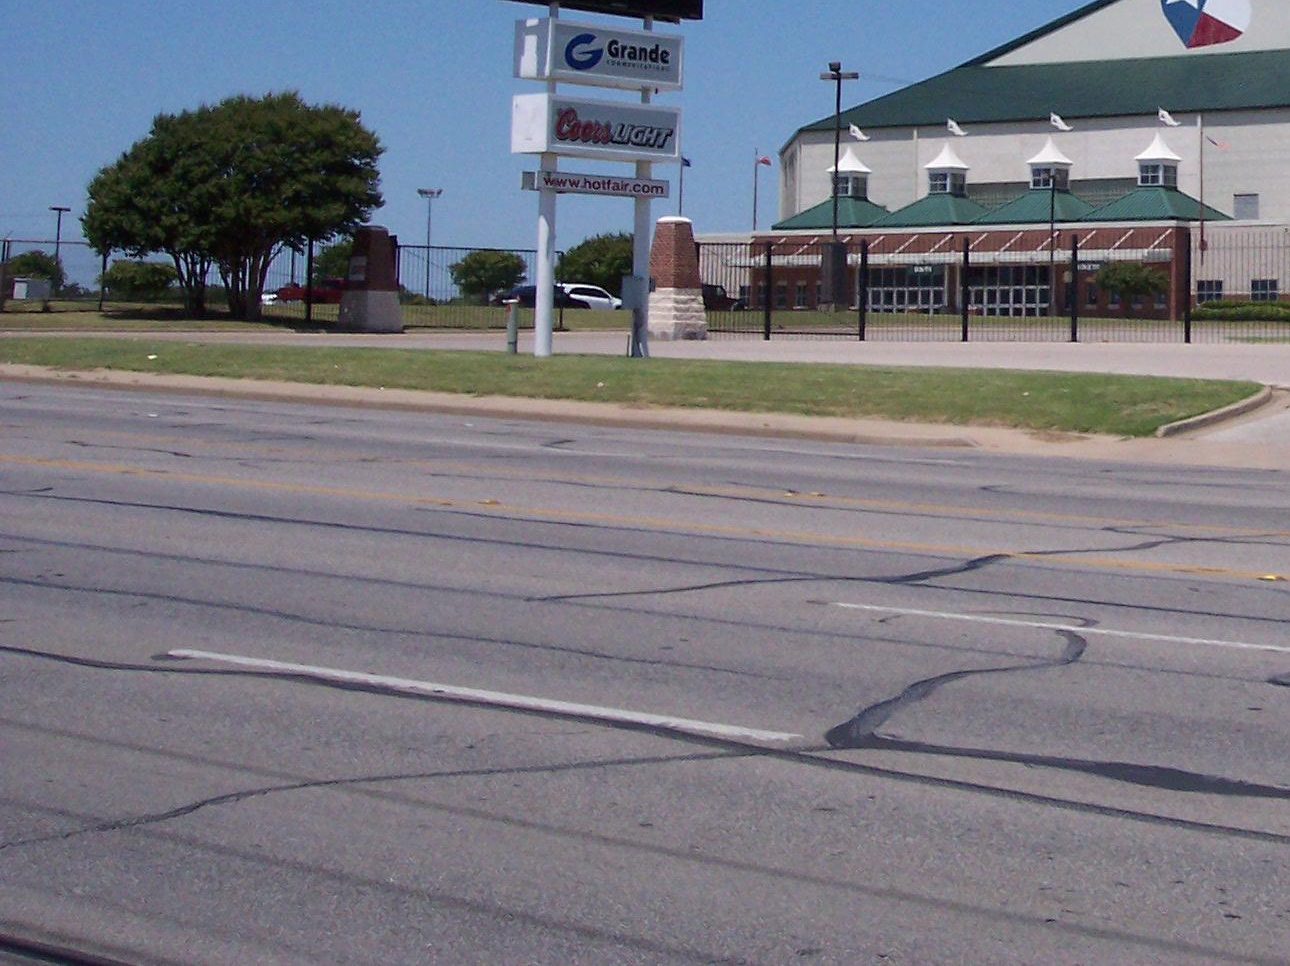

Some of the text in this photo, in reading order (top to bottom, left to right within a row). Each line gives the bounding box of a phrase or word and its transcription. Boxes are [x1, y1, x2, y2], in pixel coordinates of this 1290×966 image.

[606, 39, 671, 64] Grande
[555, 107, 673, 149] Coors LIGHT
[543, 175, 665, 194] www.hotfair.com
